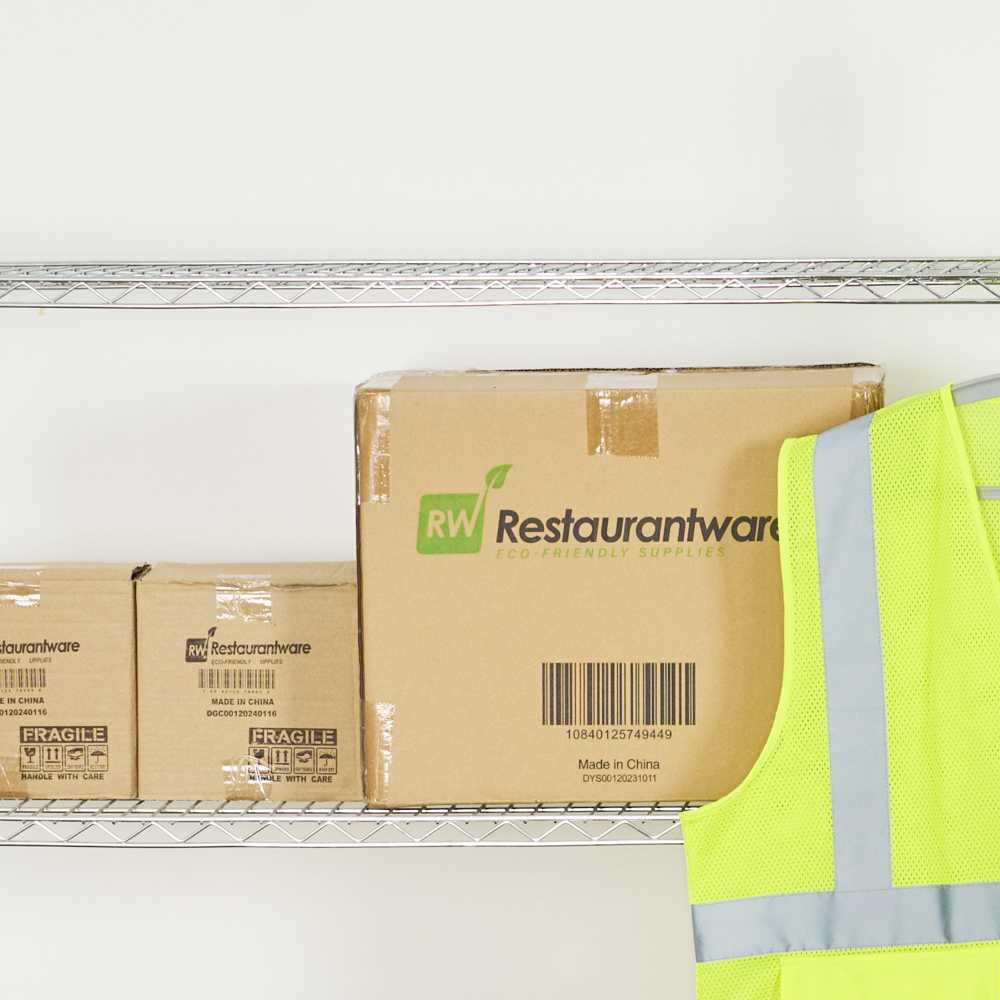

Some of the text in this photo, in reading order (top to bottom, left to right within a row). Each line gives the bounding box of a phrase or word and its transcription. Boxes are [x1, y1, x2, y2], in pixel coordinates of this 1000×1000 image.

[427, 510, 474, 539] RW
[639, 546, 726, 559] SUPPLIES
[0, 639, 80, 654] taurantware
[188, 641, 312, 657] RW Restaurantware
[211, 698, 275, 706] MADE IN CHINA
[23, 727, 105, 742] FRAGILE
[252, 729, 336, 745] FRAGILE
[566, 728, 673, 740] 10840125749449
[578, 758, 660, 771] Made in China
[21, 773, 105, 781] HANDLE WITH CARE
[285, 775, 307, 783] WITH
[311, 775, 333, 783] CARE
[582, 774, 657, 783] DYS00120231011
